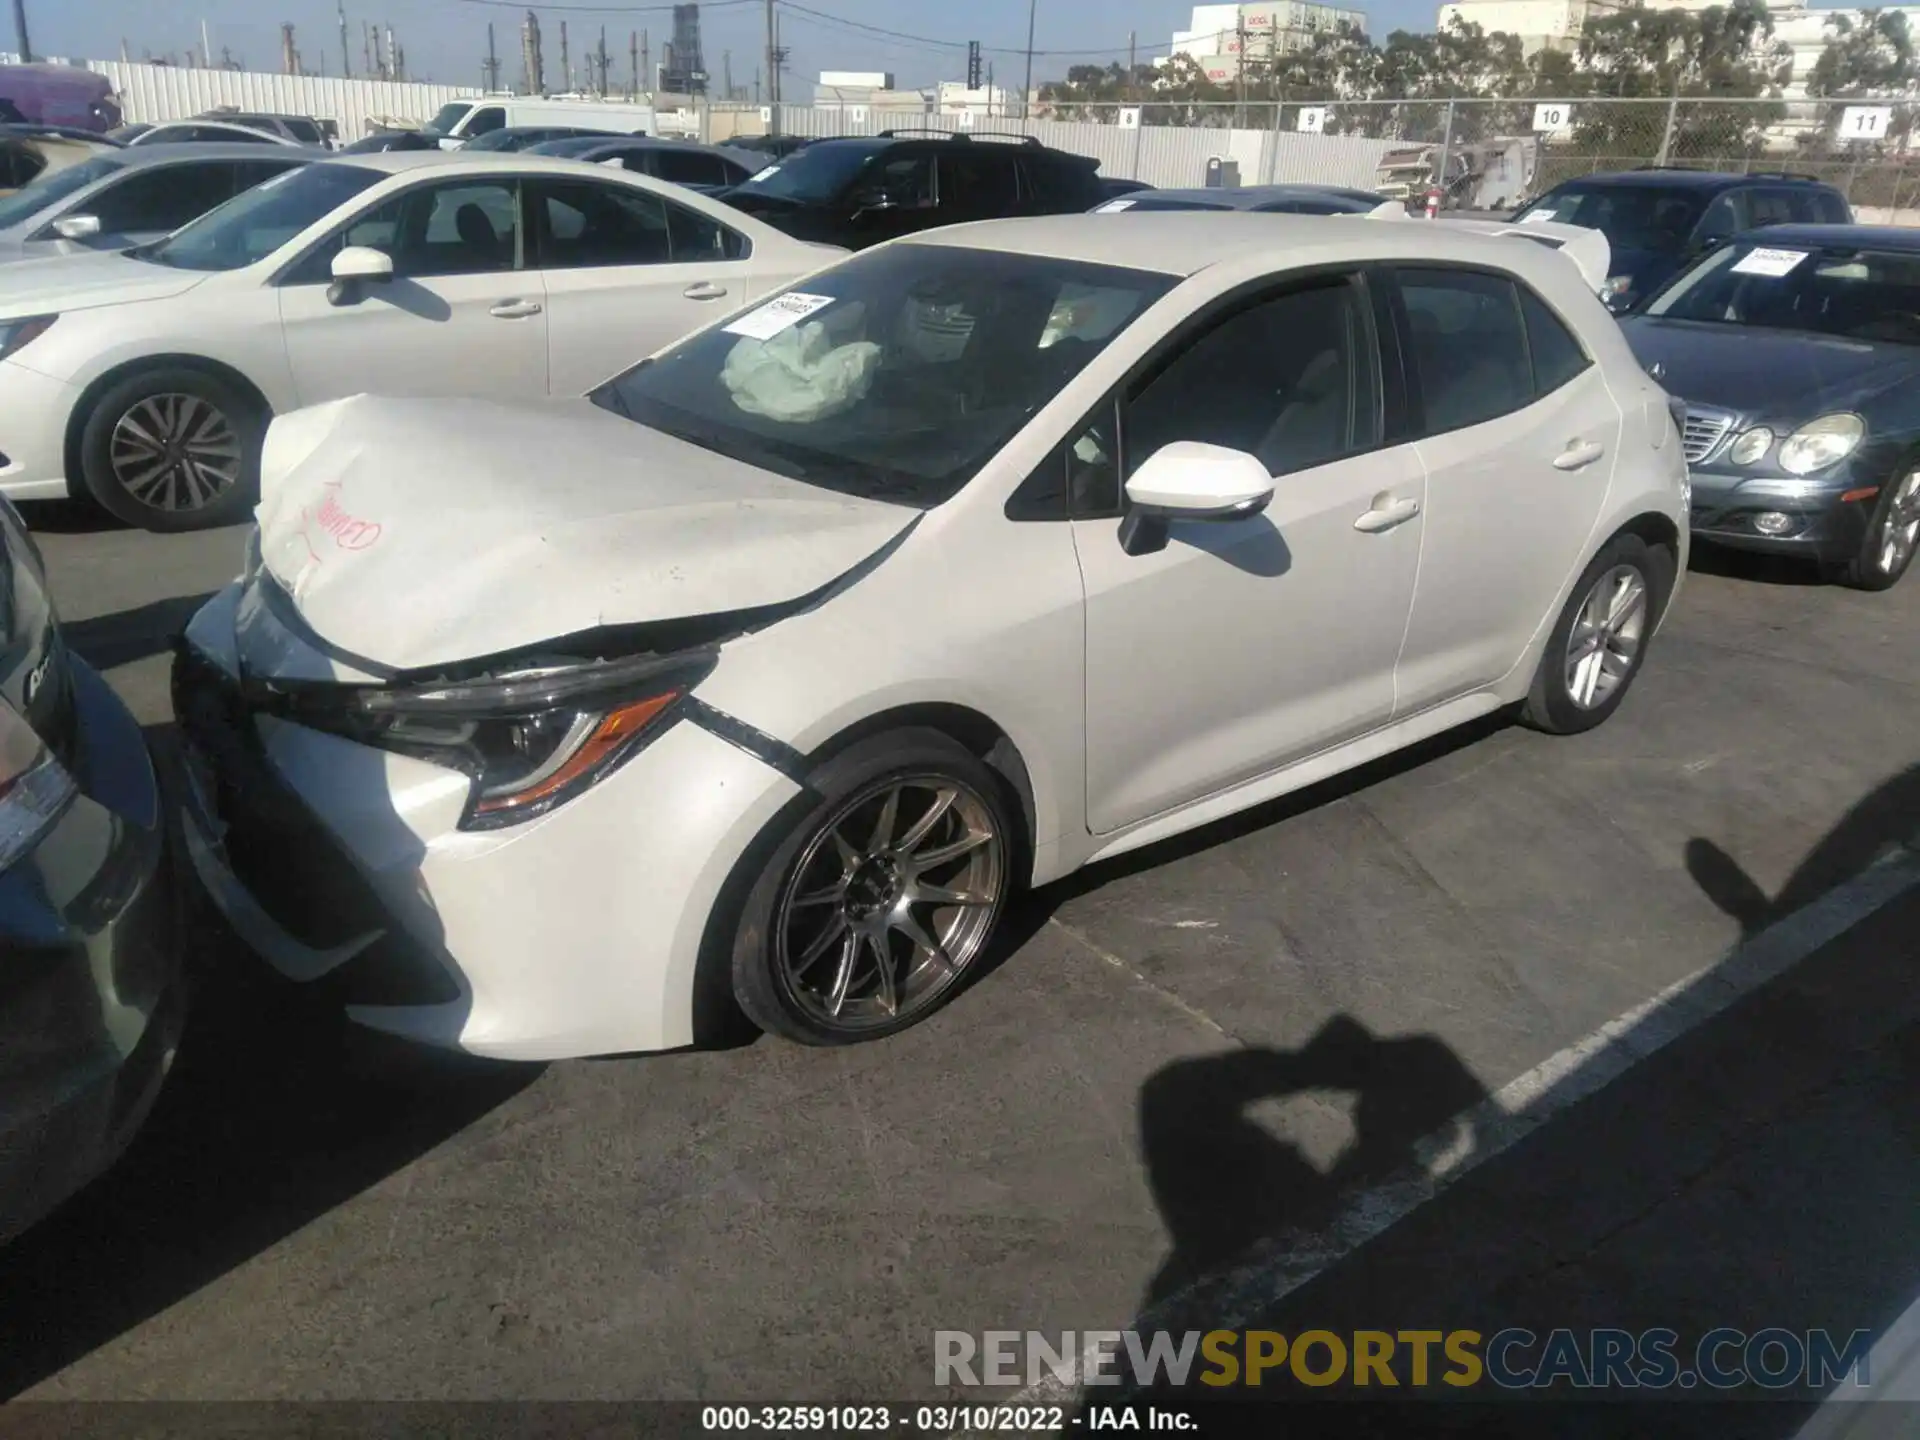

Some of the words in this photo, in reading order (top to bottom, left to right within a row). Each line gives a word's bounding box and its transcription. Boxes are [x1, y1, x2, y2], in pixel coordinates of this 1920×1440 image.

[1126, 112, 1133, 125] 8
[1307, 113, 1316, 126] 9
[1543, 109, 1561, 125] 10
[1856, 114, 1877, 131] 11
